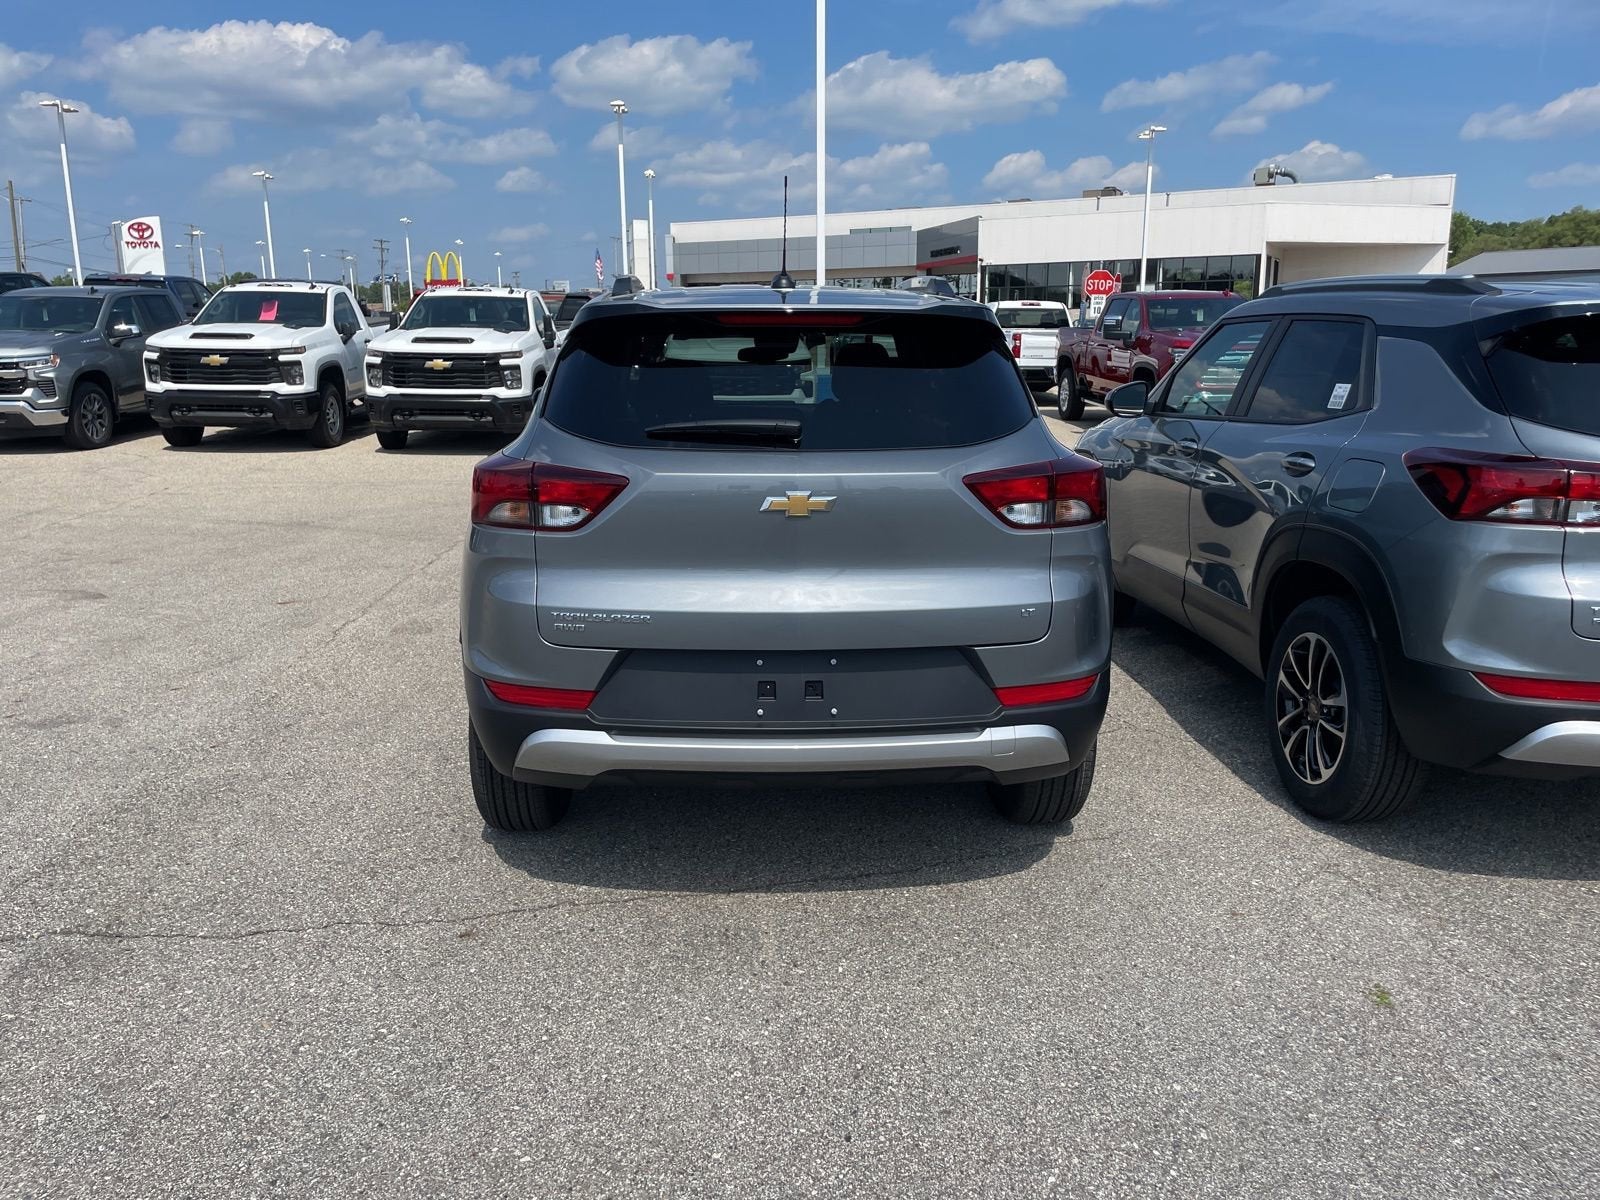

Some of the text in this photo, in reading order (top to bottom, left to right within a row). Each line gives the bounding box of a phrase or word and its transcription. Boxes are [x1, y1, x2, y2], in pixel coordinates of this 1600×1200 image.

[125, 241, 161, 249] TOYOTA
[1087, 279, 1113, 291] STOP
[1093, 306, 1102, 315] 10
[1021, 607, 1036, 617] LT
[551, 611, 652, 624] TRAILBLAZER
